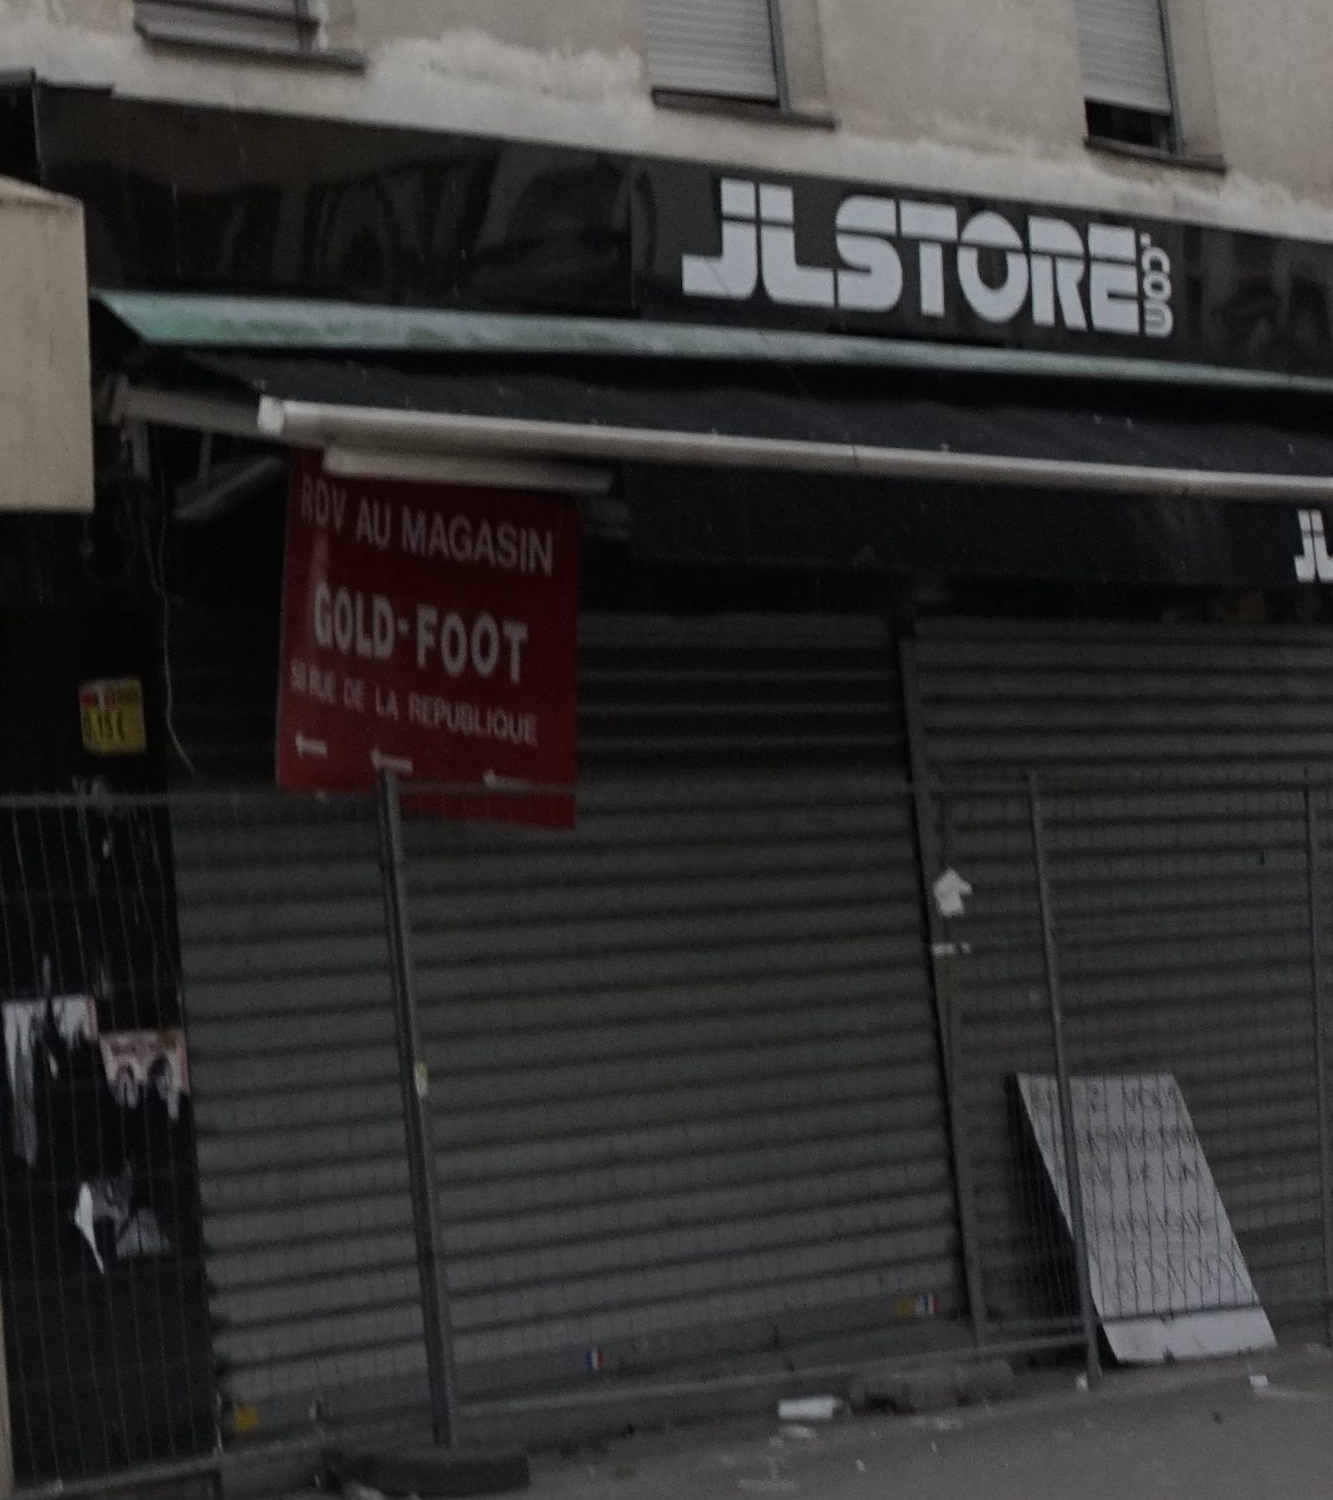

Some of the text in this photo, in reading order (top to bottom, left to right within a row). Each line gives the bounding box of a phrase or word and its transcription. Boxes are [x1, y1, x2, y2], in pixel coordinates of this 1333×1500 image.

[300, 472, 554, 578] RDV AU MAGASIN
[343, 676, 365, 713] DE
[375, 684, 399, 721] LA
[409, 691, 538, 747] REPUBLIQUE
